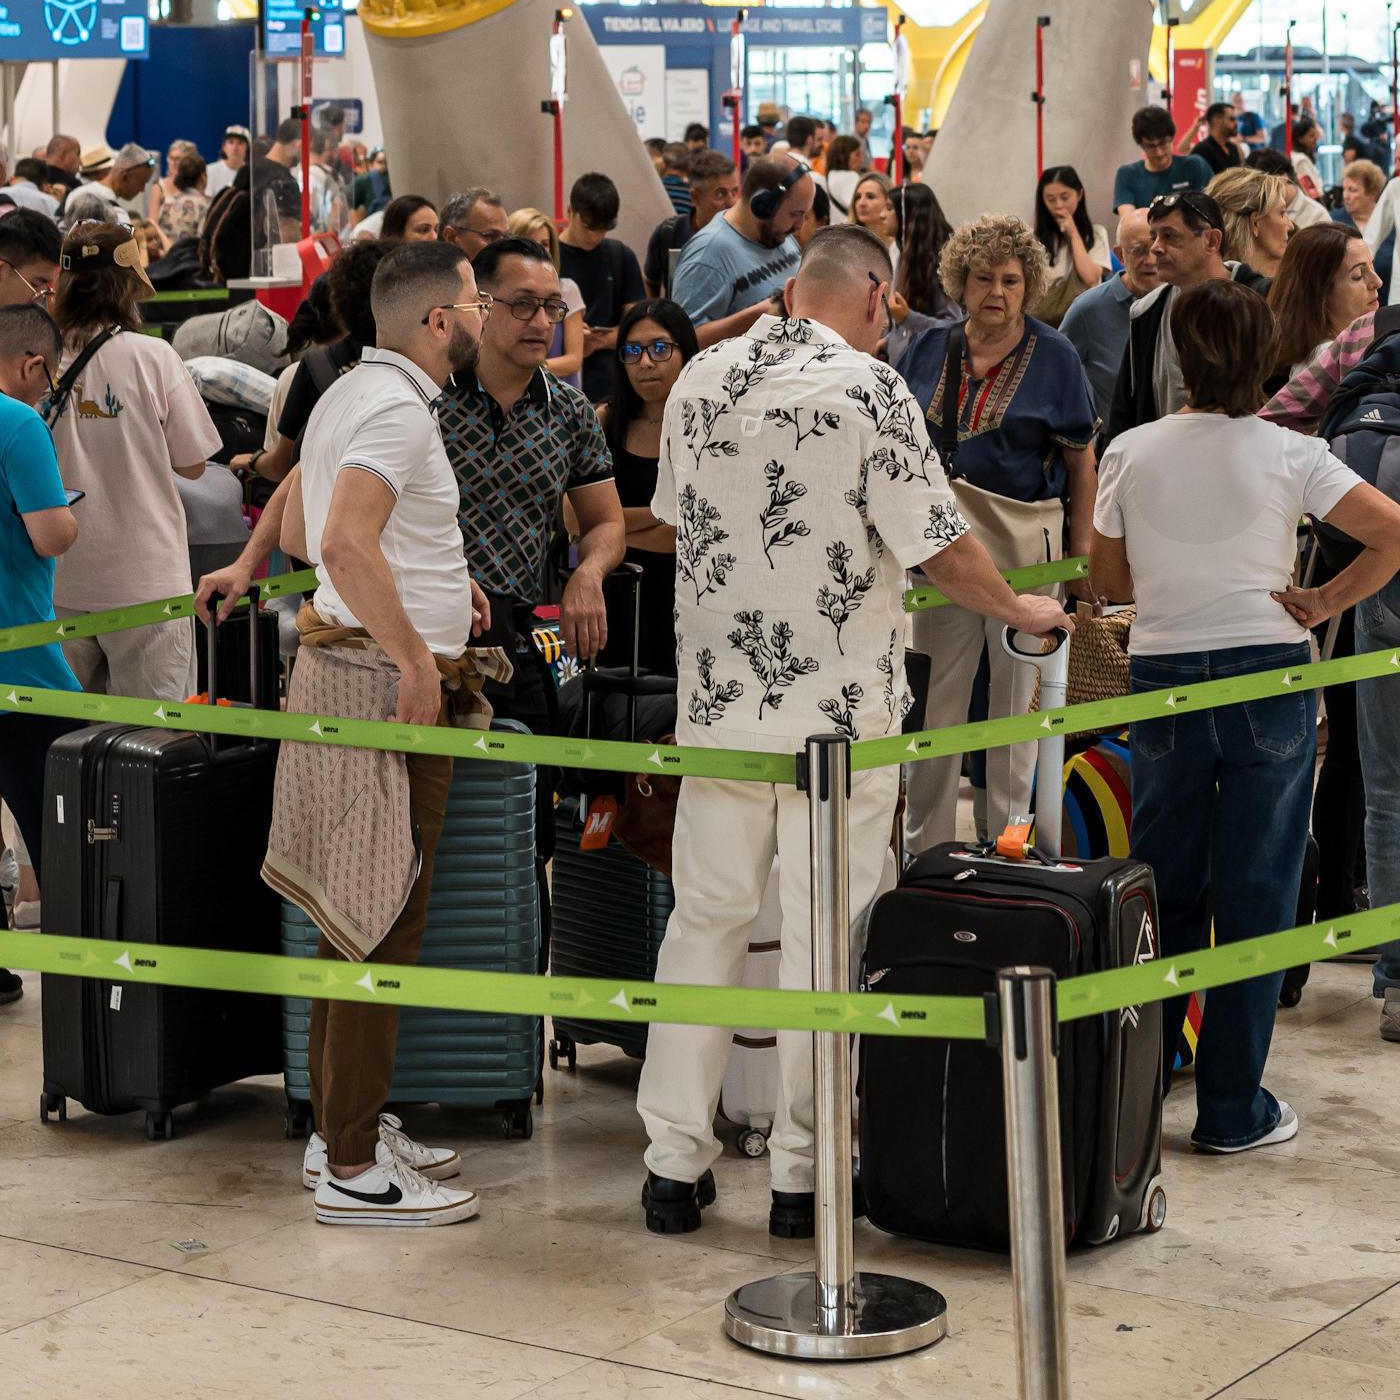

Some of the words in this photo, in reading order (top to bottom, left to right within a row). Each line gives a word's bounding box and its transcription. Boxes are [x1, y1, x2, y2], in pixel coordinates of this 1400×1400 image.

[587, 812, 612, 835] M
[1336, 930, 1352, 940] aena
[134, 958, 157, 968] aena
[1178, 969, 1195, 978] aena
[376, 979, 401, 989] aena
[631, 997, 657, 1006] aena
[900, 1010, 927, 1020] aena
